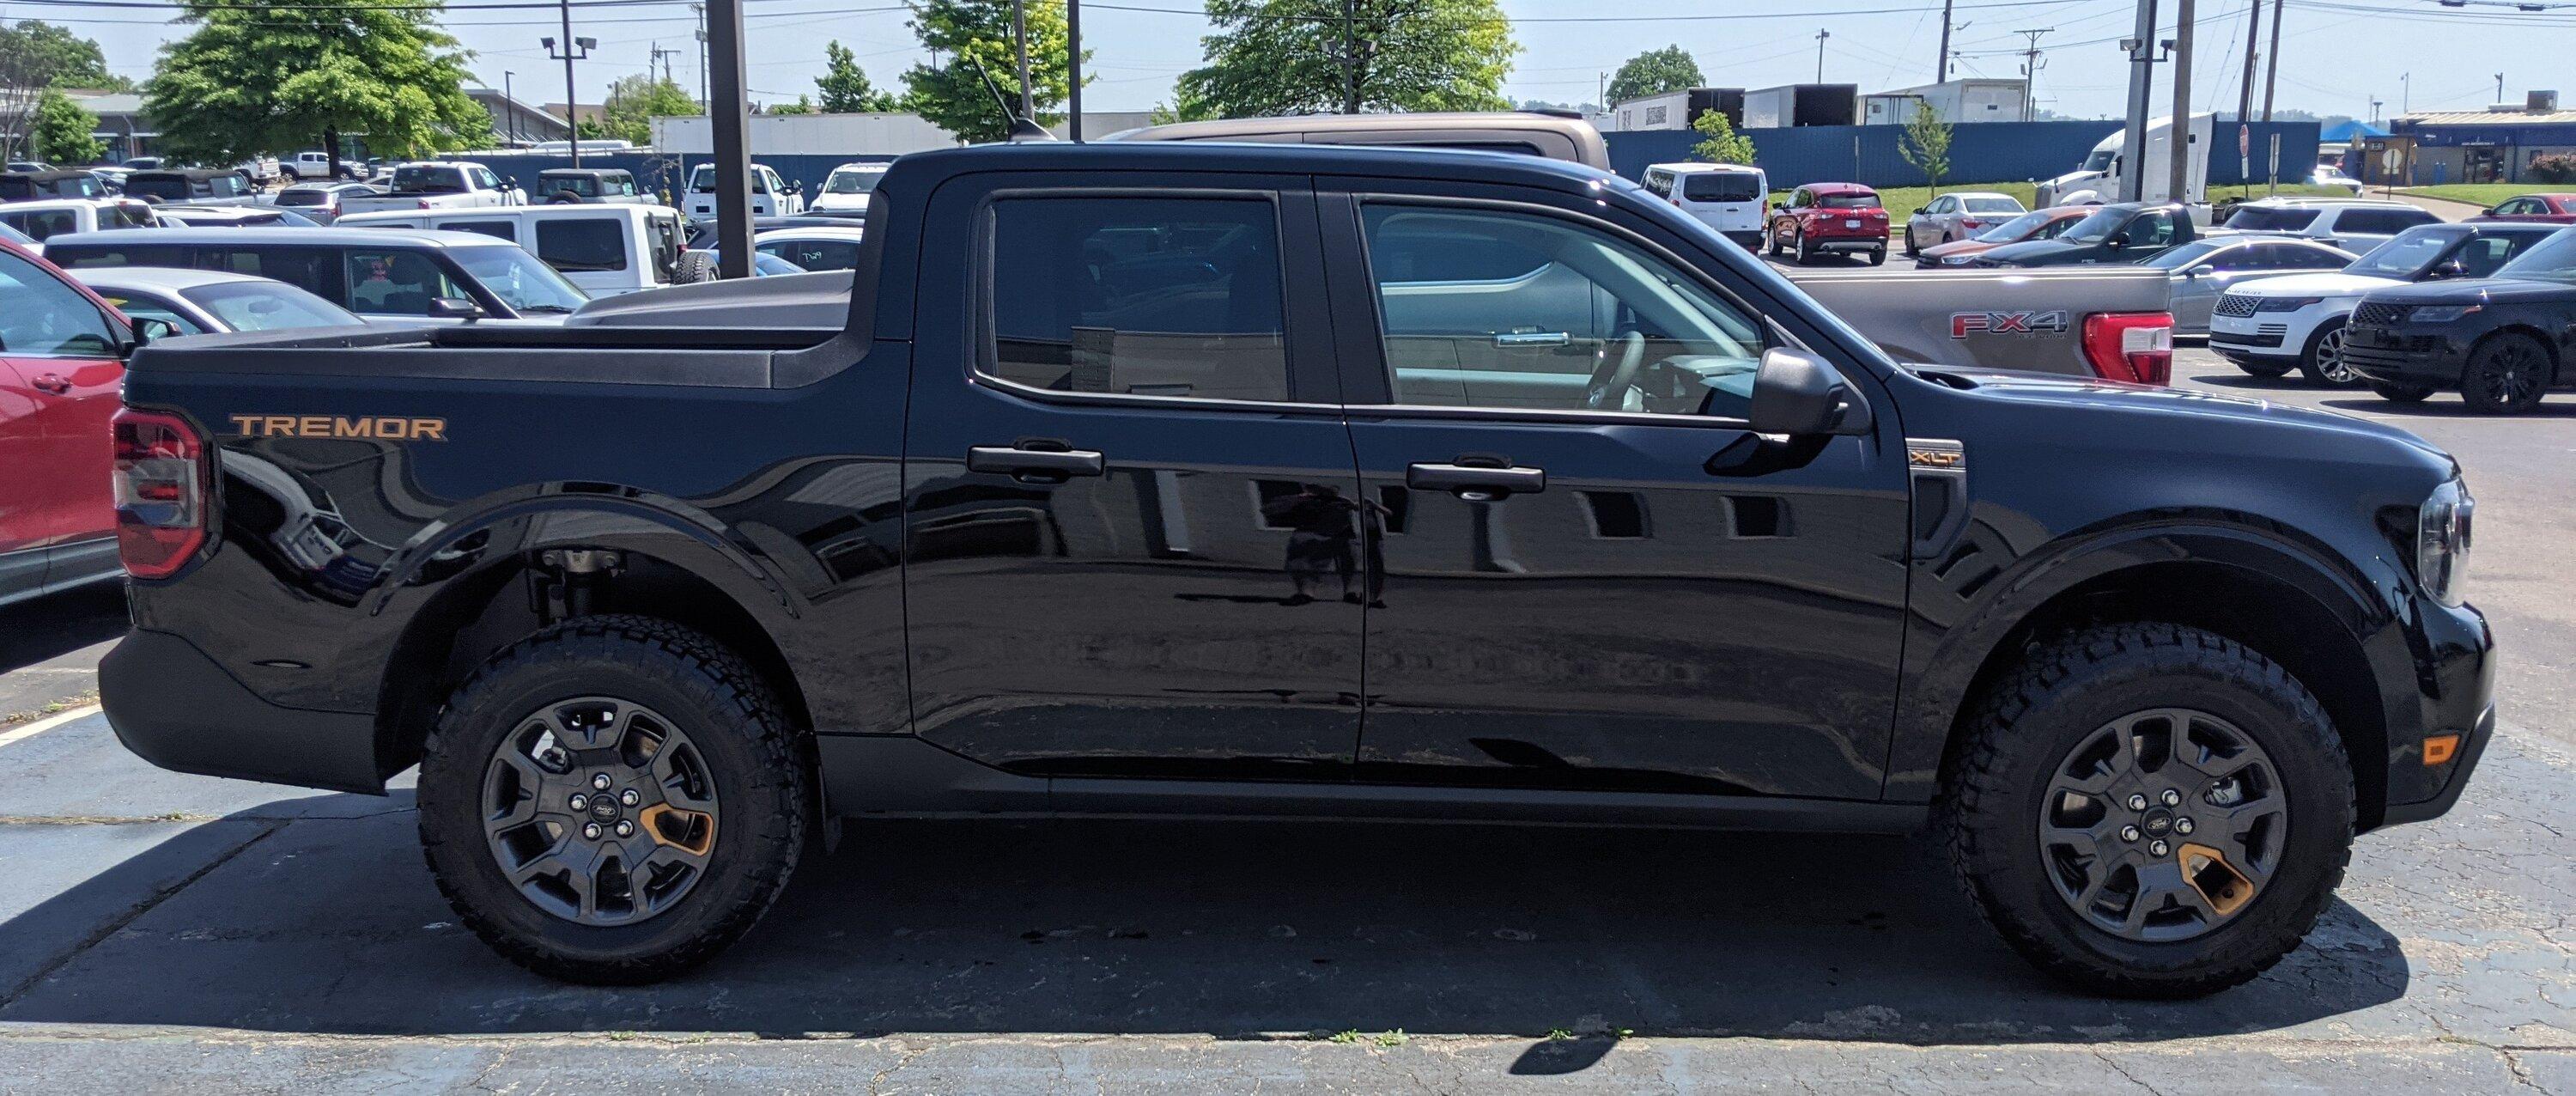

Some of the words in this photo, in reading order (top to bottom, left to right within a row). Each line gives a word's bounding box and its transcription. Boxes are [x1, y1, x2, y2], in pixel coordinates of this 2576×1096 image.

[1950, 310, 2069, 340] FX4
[229, 413, 447, 441] TREMOR
[1911, 451, 1961, 466] XLT
